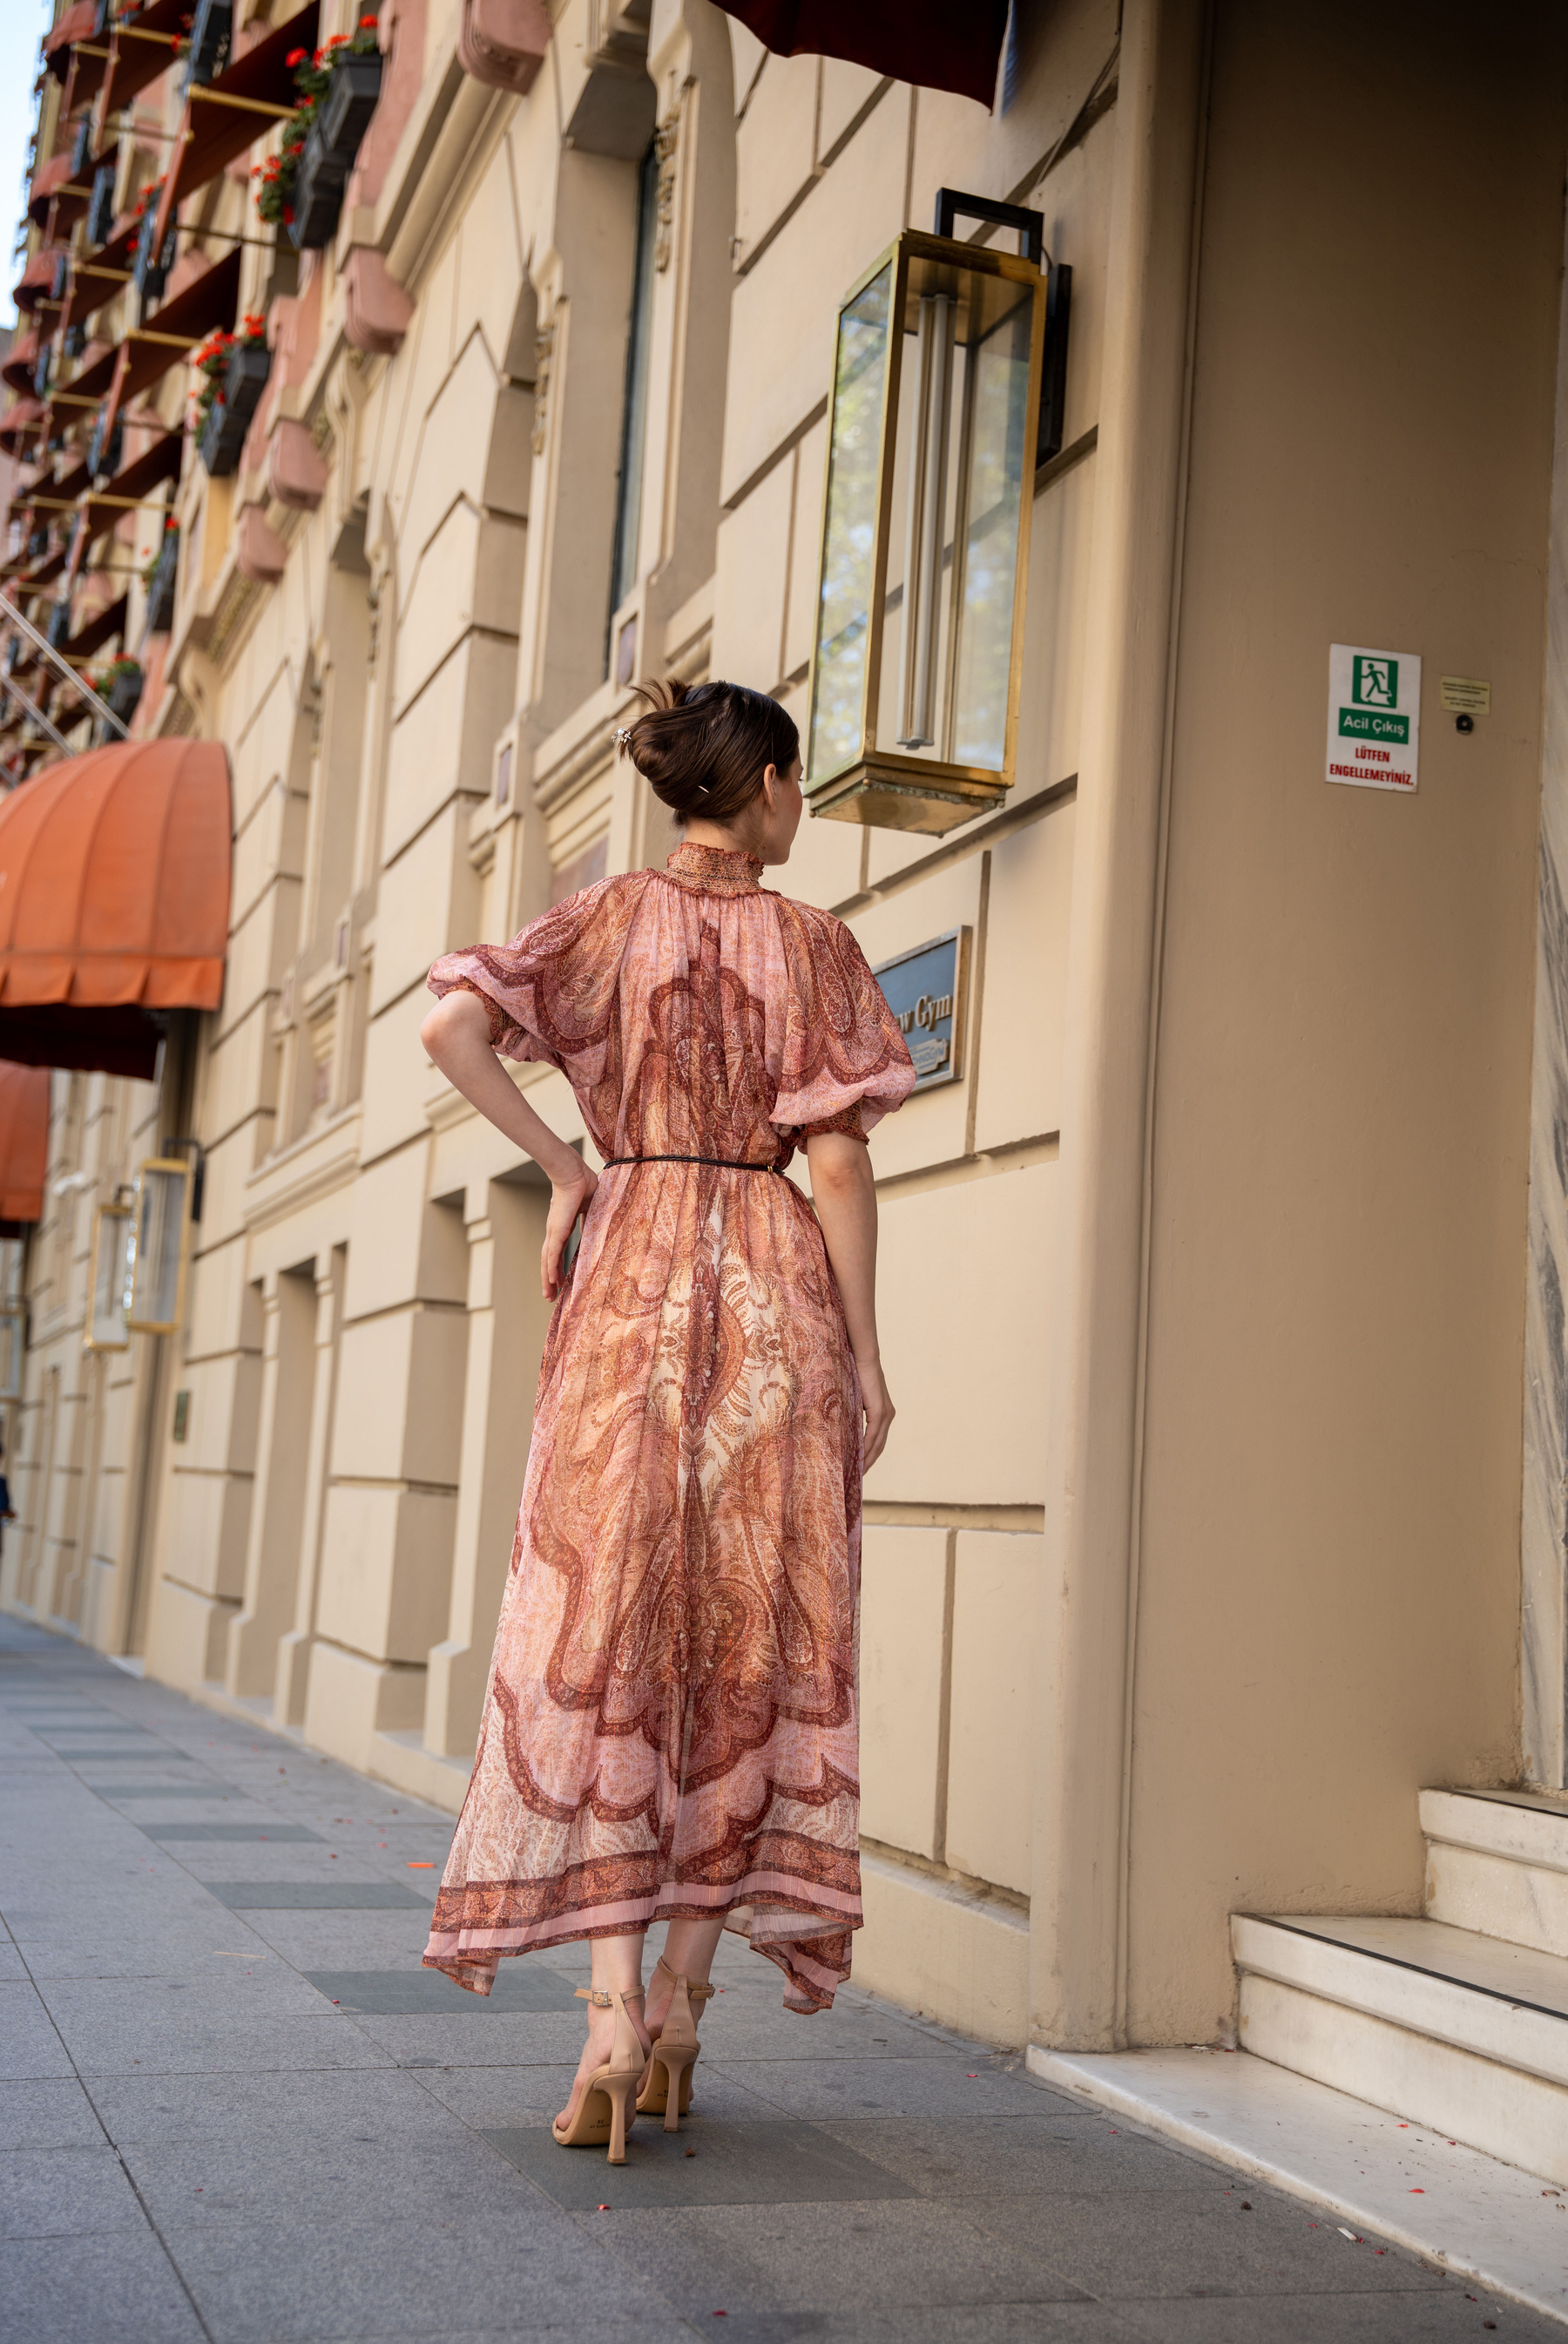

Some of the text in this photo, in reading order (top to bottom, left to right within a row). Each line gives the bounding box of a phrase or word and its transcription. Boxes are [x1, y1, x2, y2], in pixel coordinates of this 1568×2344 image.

[1343, 715, 1405, 737] Acil Çıkış
[1355, 745, 1390, 762] LÜTFEN
[1329, 763, 1414, 786] ENGELLEMEYİNİZ.
[915, 995, 951, 1032] Gym
